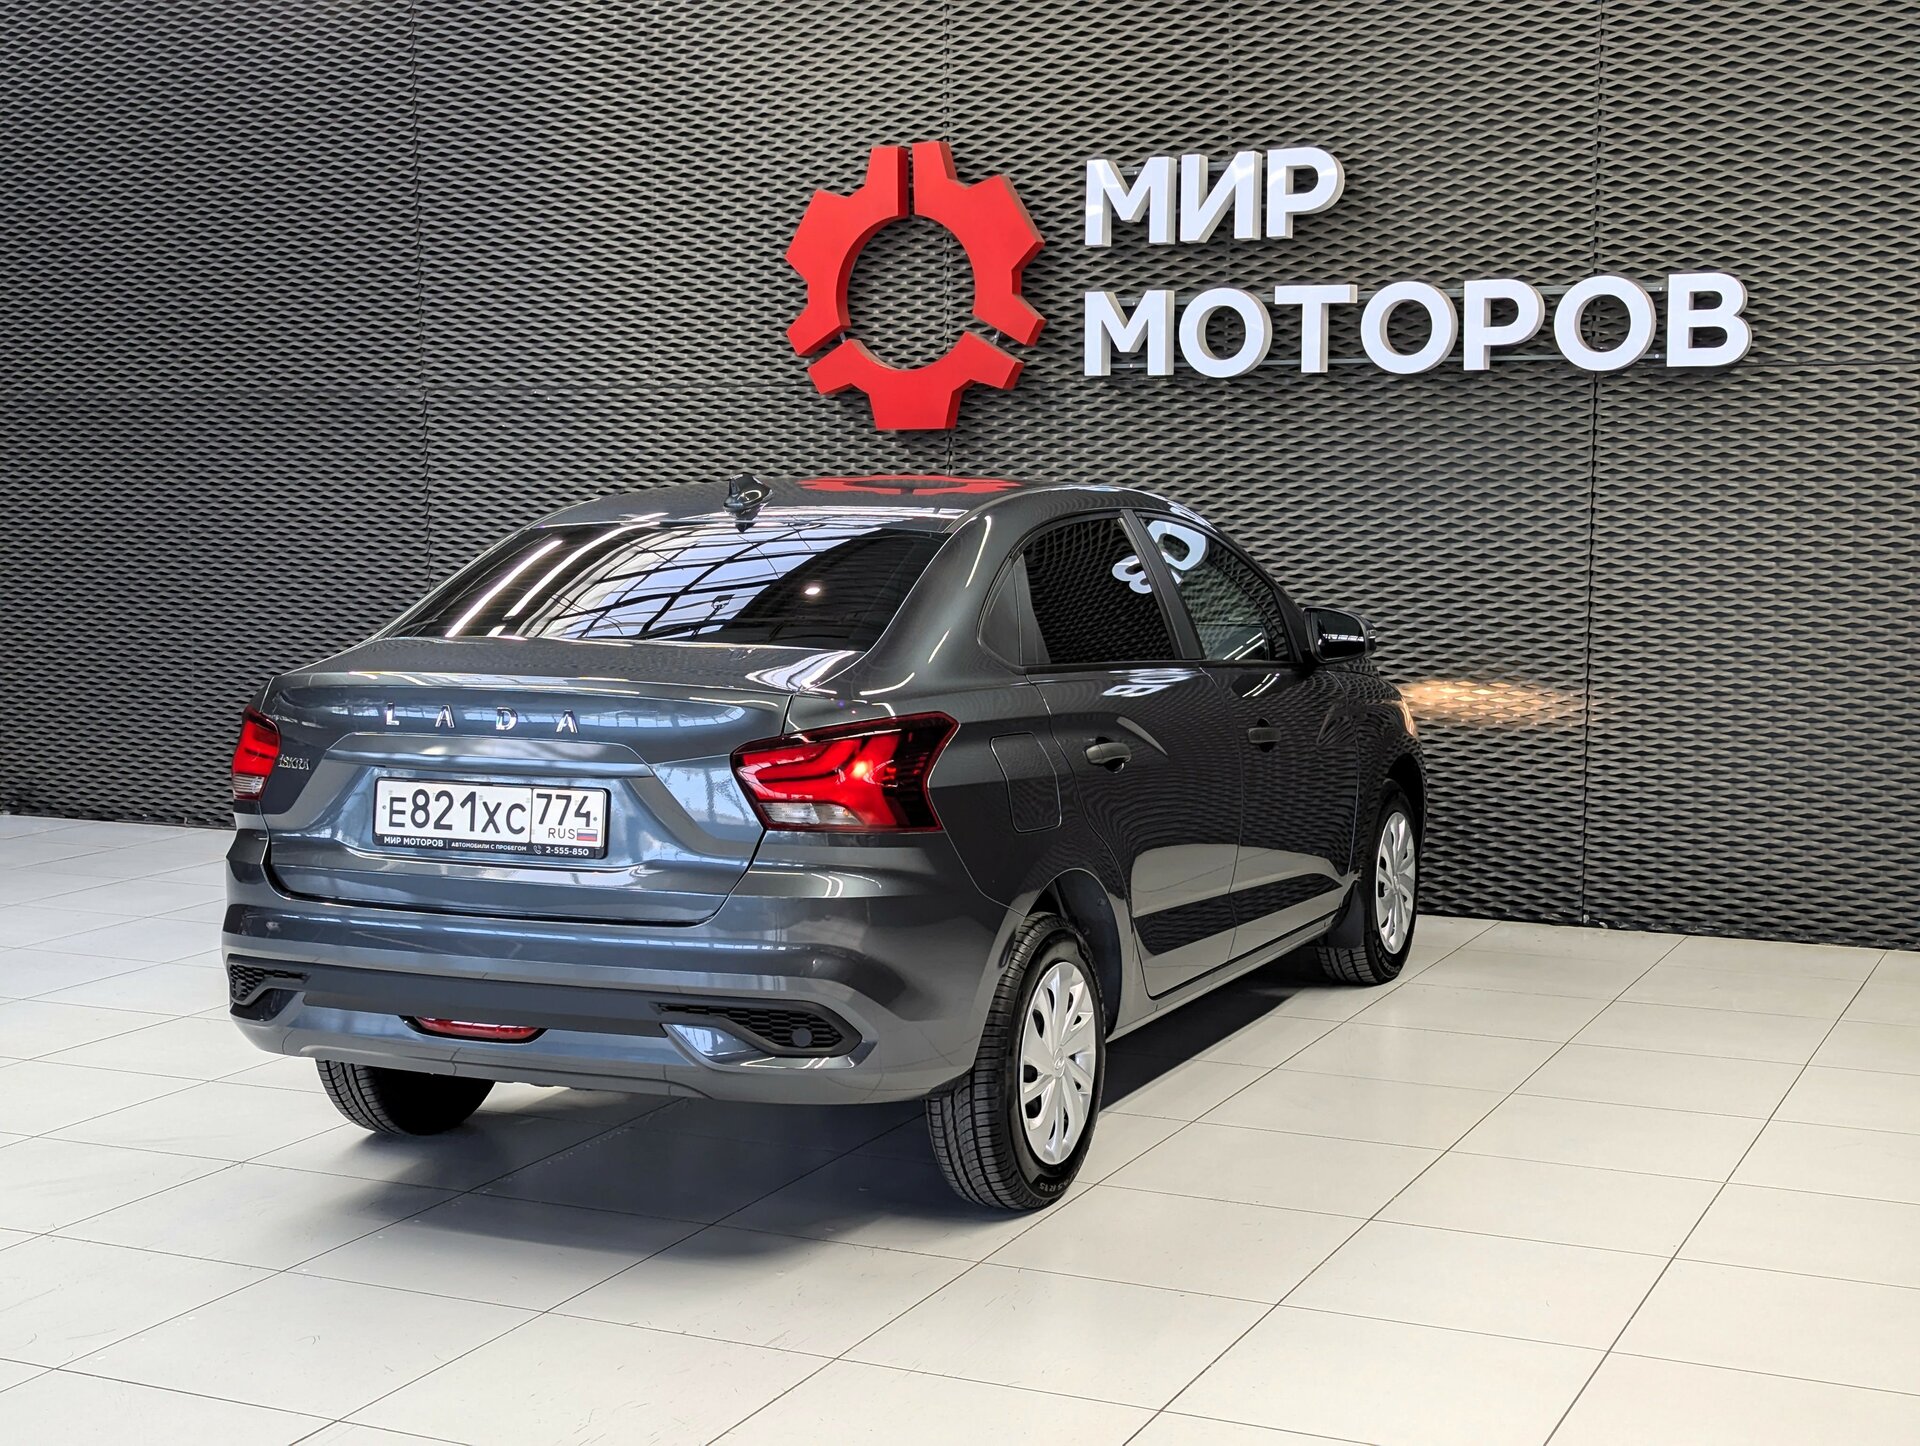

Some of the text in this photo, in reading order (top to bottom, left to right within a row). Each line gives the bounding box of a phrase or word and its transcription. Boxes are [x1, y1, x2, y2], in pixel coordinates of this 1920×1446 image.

[1084, 146, 1345, 247] МИР
[1083, 272, 1752, 379] МОТОРОВ
[386, 702, 578, 734] LADA
[388, 788, 592, 835] Е821ХС 774
[384, 836, 402, 844] МИР
[403, 837, 444, 847] МОТОРОВ
[451, 842, 489, 850] АВТОМОБИЛИ
[545, 846, 590, 856] 2-555-850
[548, 827, 576, 840] RUS
